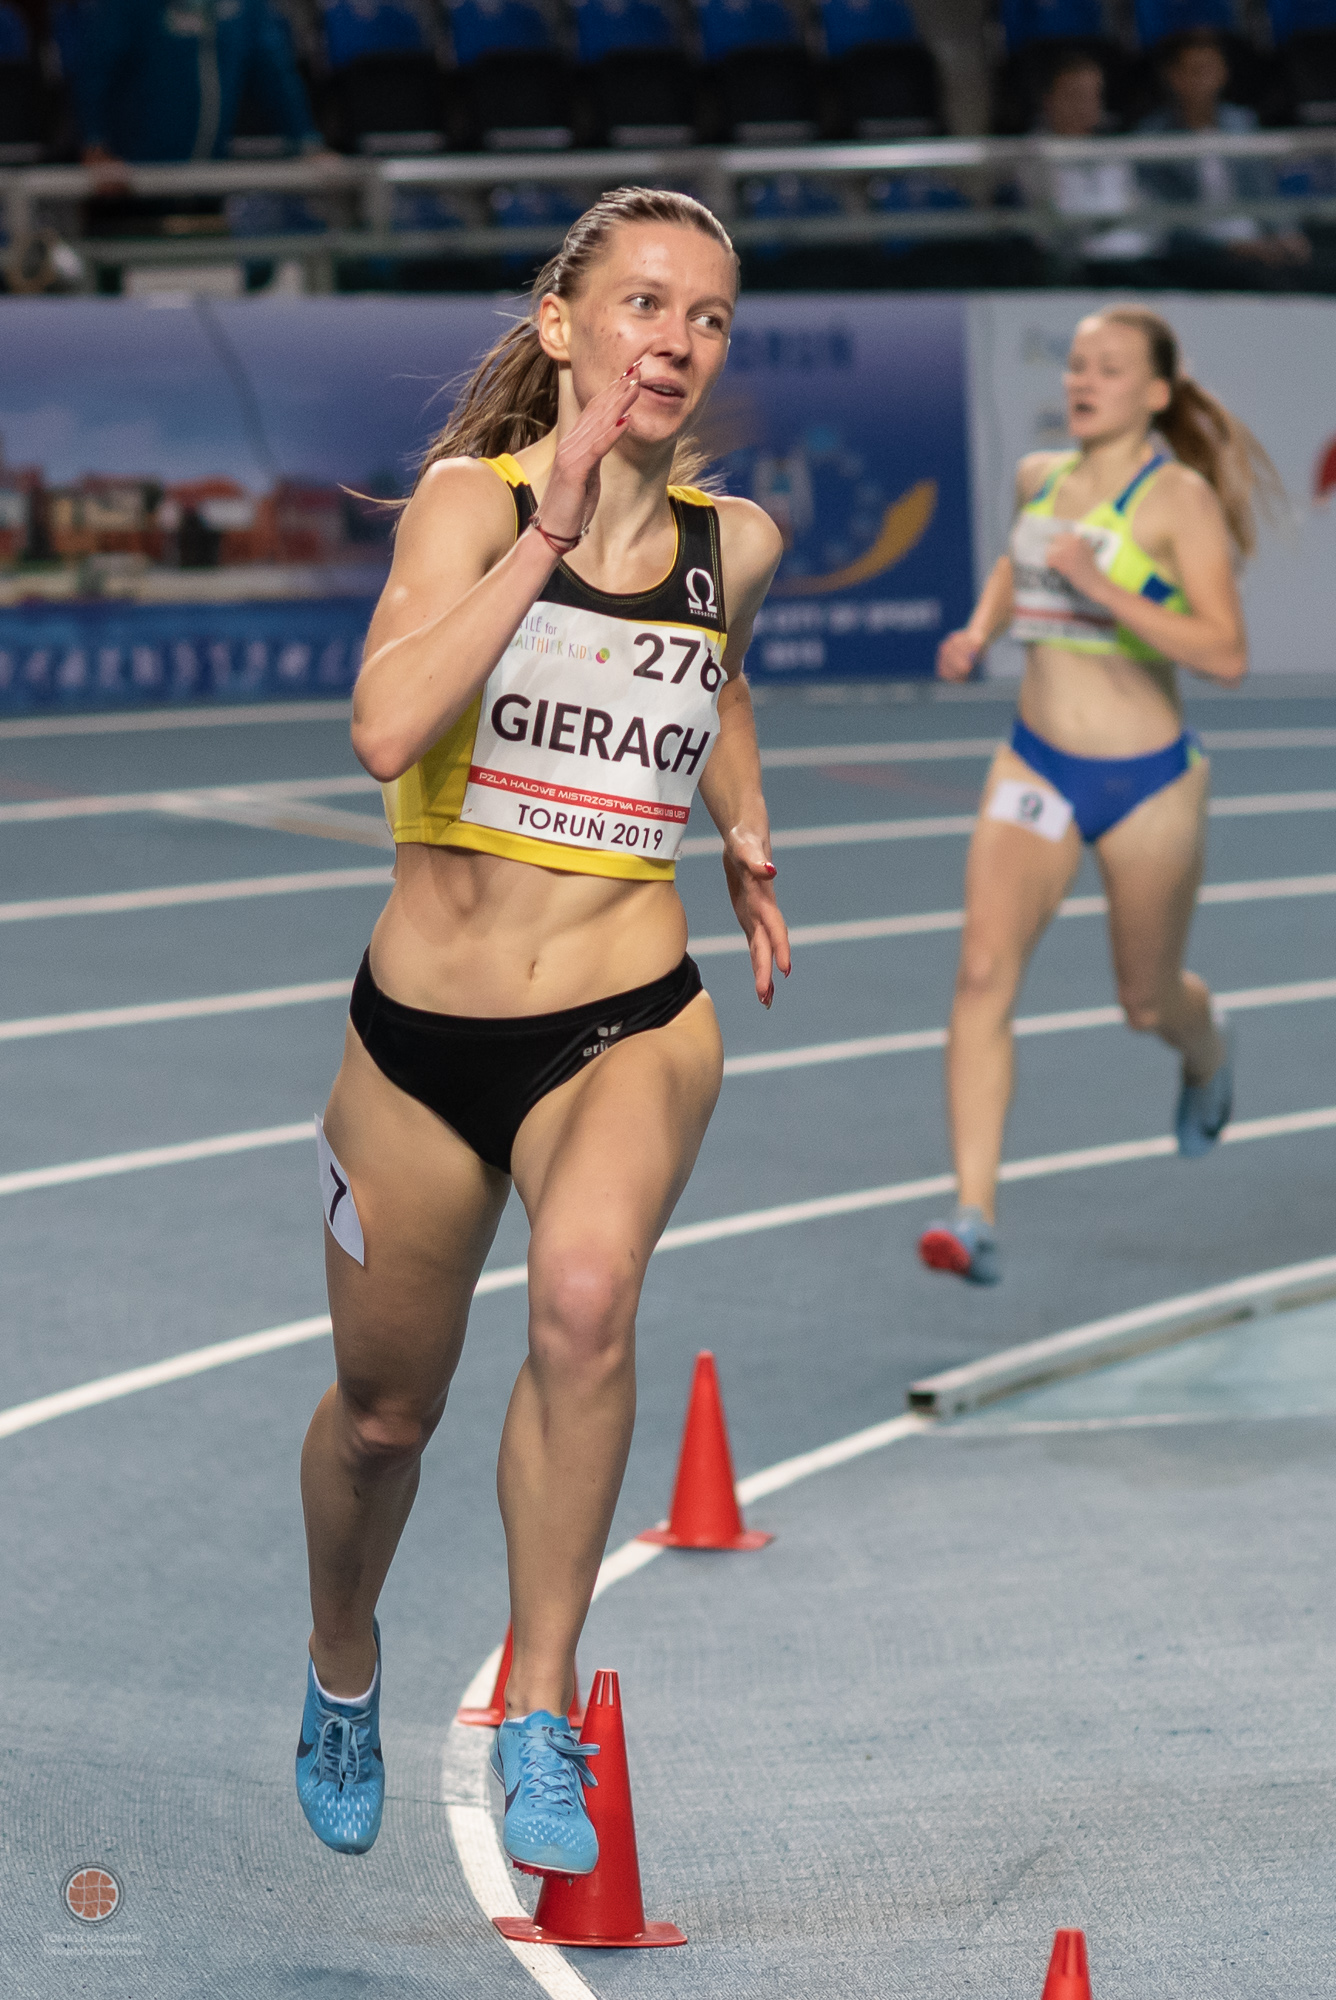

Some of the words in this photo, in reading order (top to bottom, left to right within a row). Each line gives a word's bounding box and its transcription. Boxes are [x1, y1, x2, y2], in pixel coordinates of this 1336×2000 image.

[510, 634, 563, 656] ALTHIER
[568, 643, 593, 660] KIDS
[520, 615, 543, 632] ILE
[545, 622, 557, 635] for
[633, 632, 722, 693] 276
[491, 693, 711, 776] GIERACH
[479, 772, 508, 786] PZLA
[510, 779, 556, 797] HALOWE
[558, 790, 634, 812] MISTRZOSTWA
[518, 803, 606, 841] TORUŃ
[610, 823, 664, 851] 2019
[329, 1161, 348, 1227] 7
